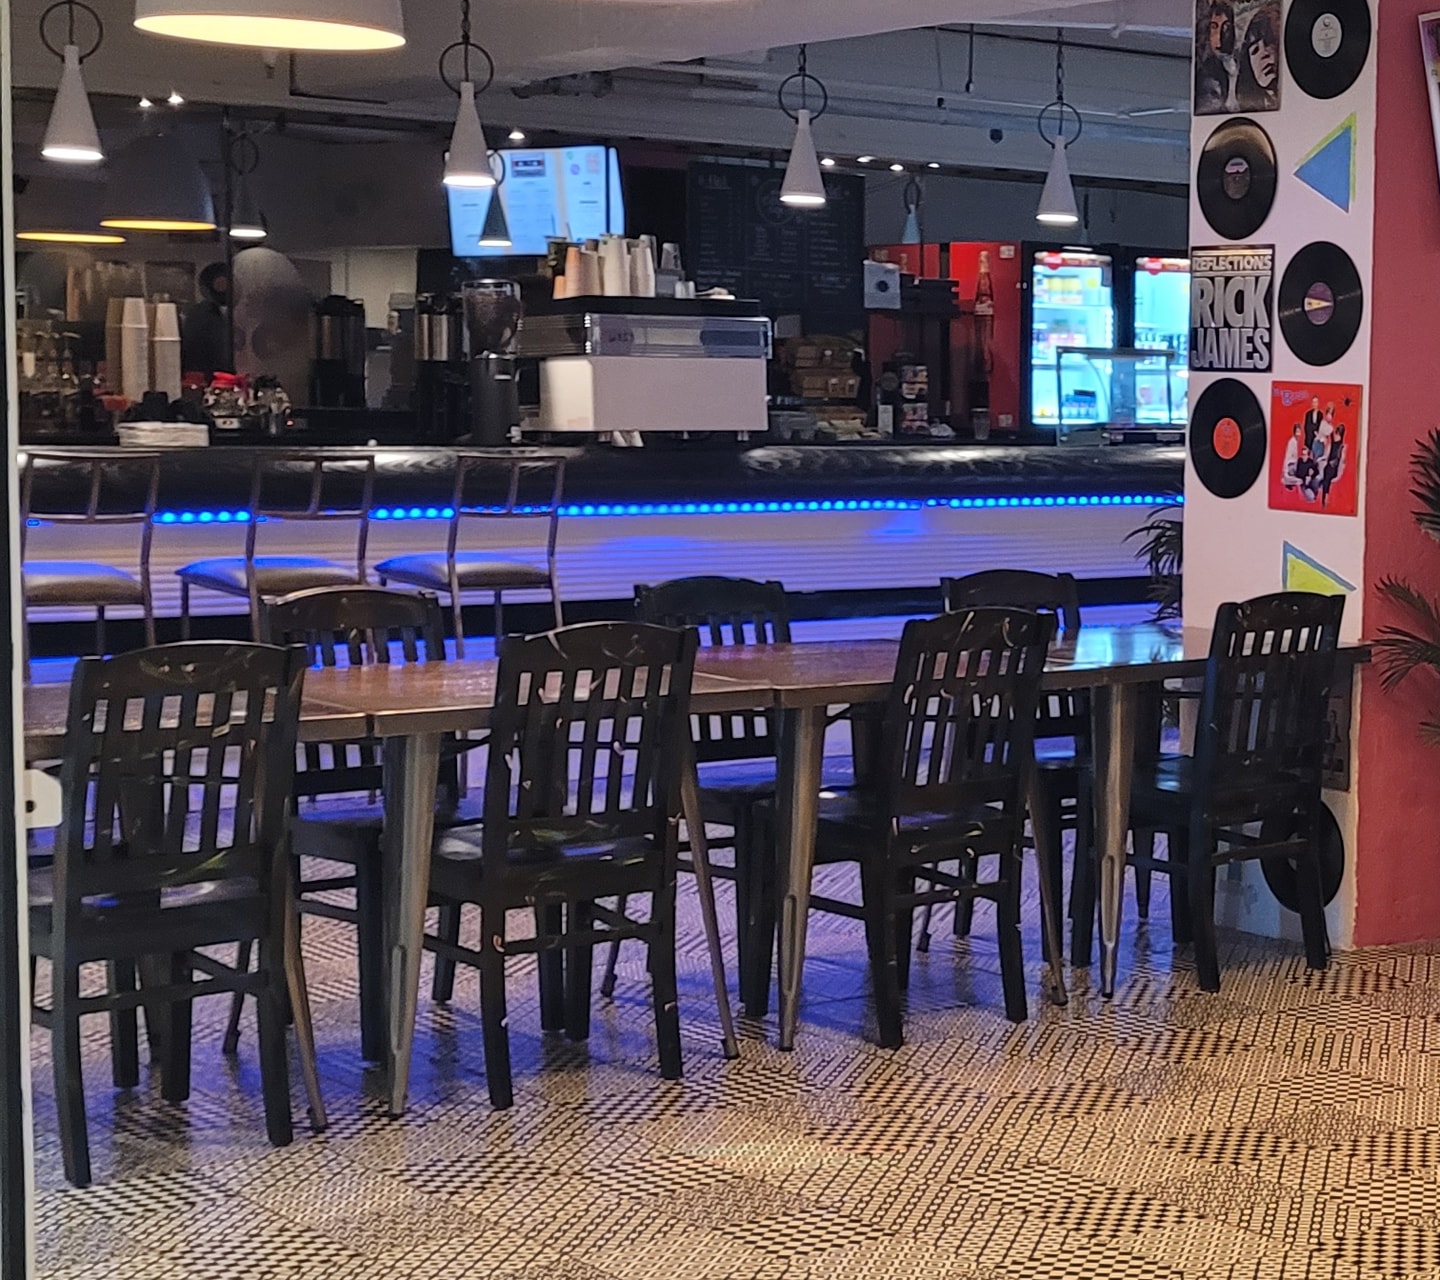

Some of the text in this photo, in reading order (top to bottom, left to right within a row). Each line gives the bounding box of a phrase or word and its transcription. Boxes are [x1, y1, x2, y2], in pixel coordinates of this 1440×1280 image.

[1192, 255, 1272, 271] REFLECTIONS
[1191, 276, 1271, 328] RICK
[1191, 327, 1270, 370] JAMES
